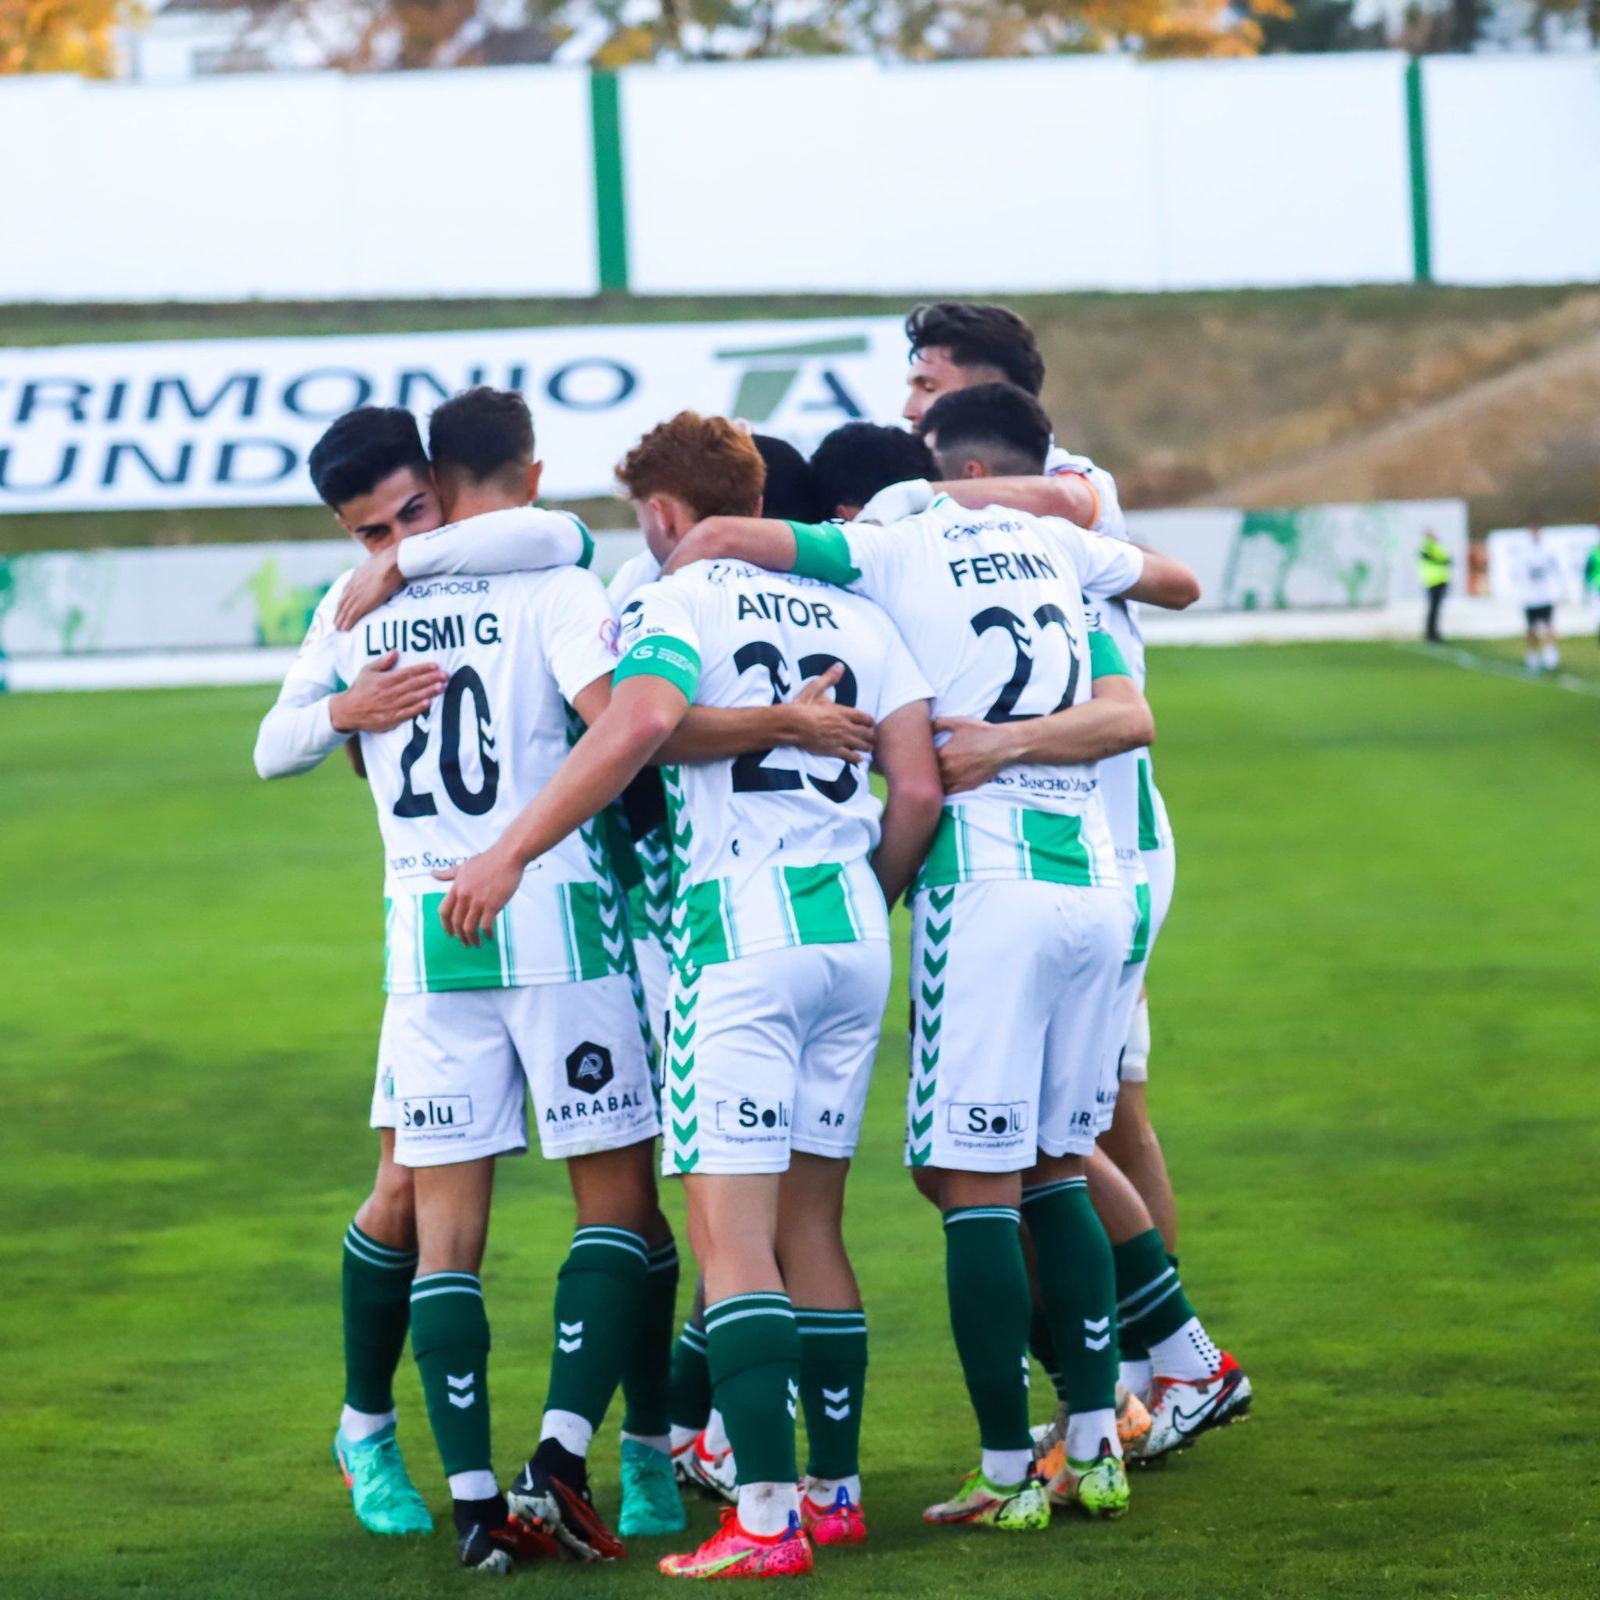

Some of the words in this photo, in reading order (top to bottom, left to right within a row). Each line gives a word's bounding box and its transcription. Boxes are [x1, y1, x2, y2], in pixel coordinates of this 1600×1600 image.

[0, 357, 636, 423] RIMONIO
[738, 593, 839, 629] AITOR
[366, 614, 465, 656] LUISMI
[475, 613, 502, 645] G.
[393, 665, 500, 819] 20
[545, 1091, 642, 1123] ARRABAL
